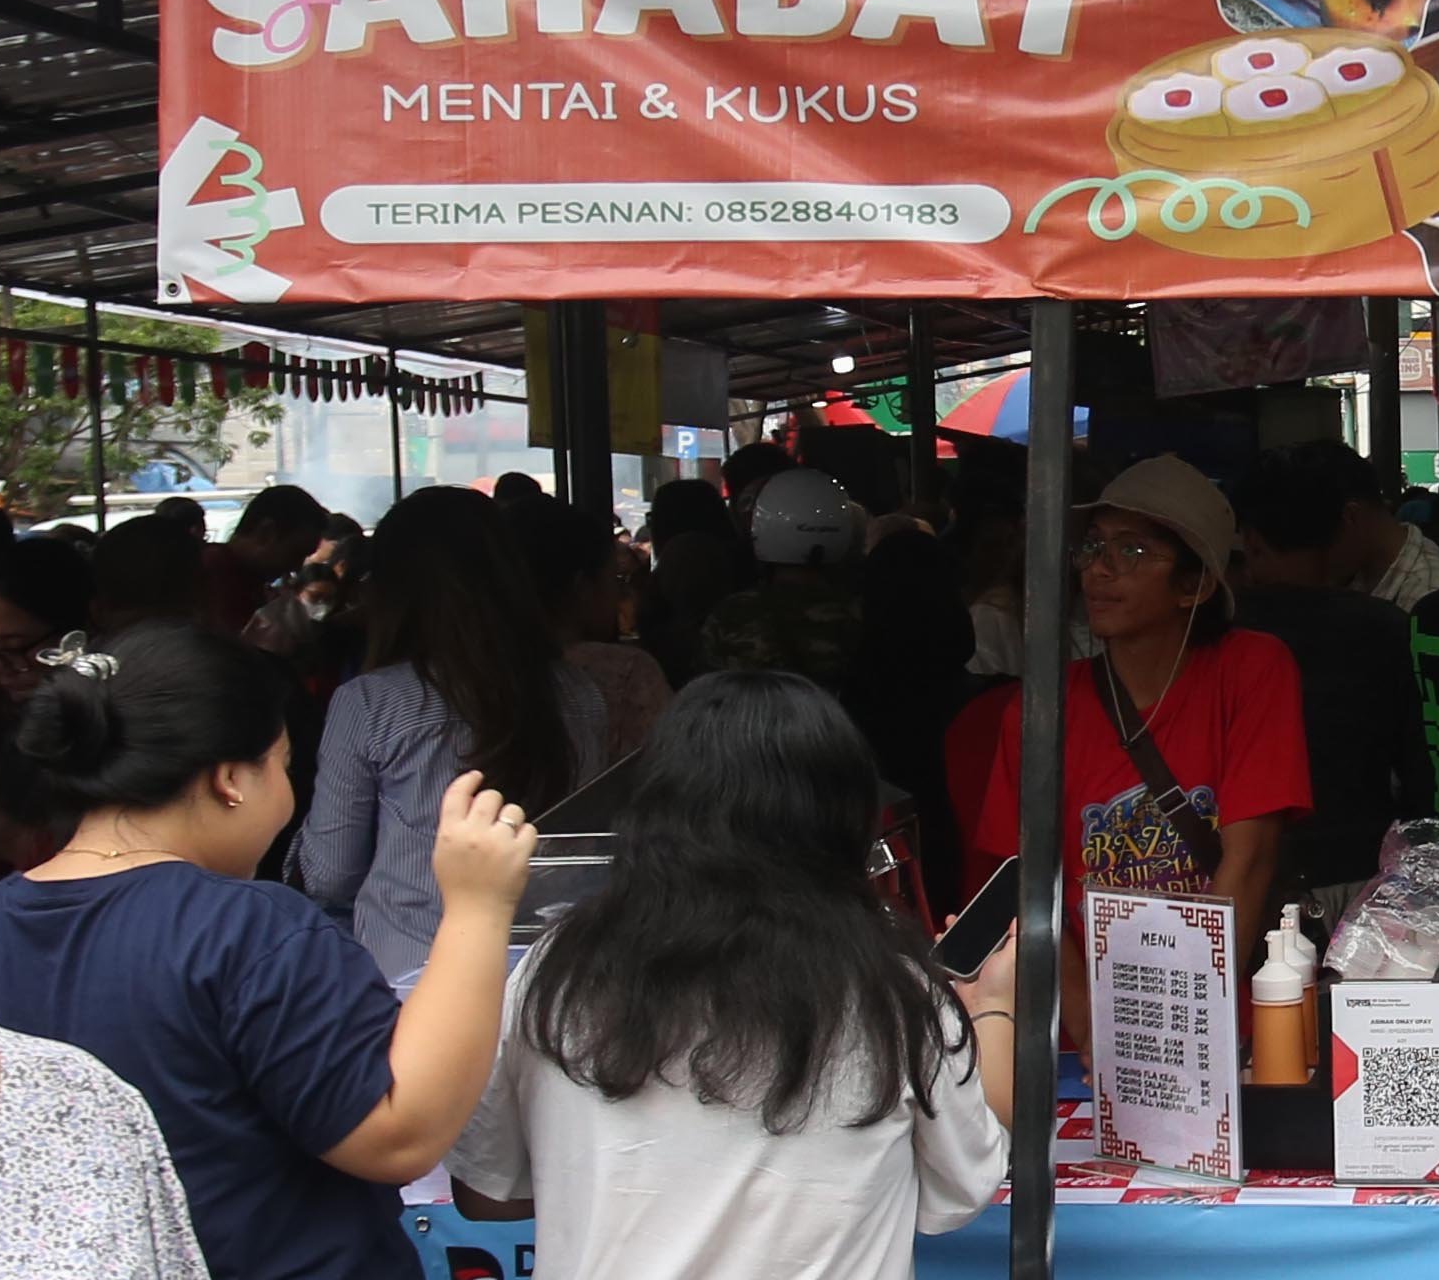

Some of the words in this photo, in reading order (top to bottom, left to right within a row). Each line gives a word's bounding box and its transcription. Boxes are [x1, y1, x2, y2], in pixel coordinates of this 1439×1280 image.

[381, 81, 619, 123] MENTAI
[639, 83, 679, 121] &
[705, 84, 919, 124] KUKUS
[367, 200, 507, 226] TERIMA
[516, 200, 693, 226] PESANAN:
[703, 200, 960, 227] 085288401983
[1400, 364, 1420, 373] ING
[1082, 825, 1183, 872] BAZ
[1141, 932, 1176, 949] MENU
